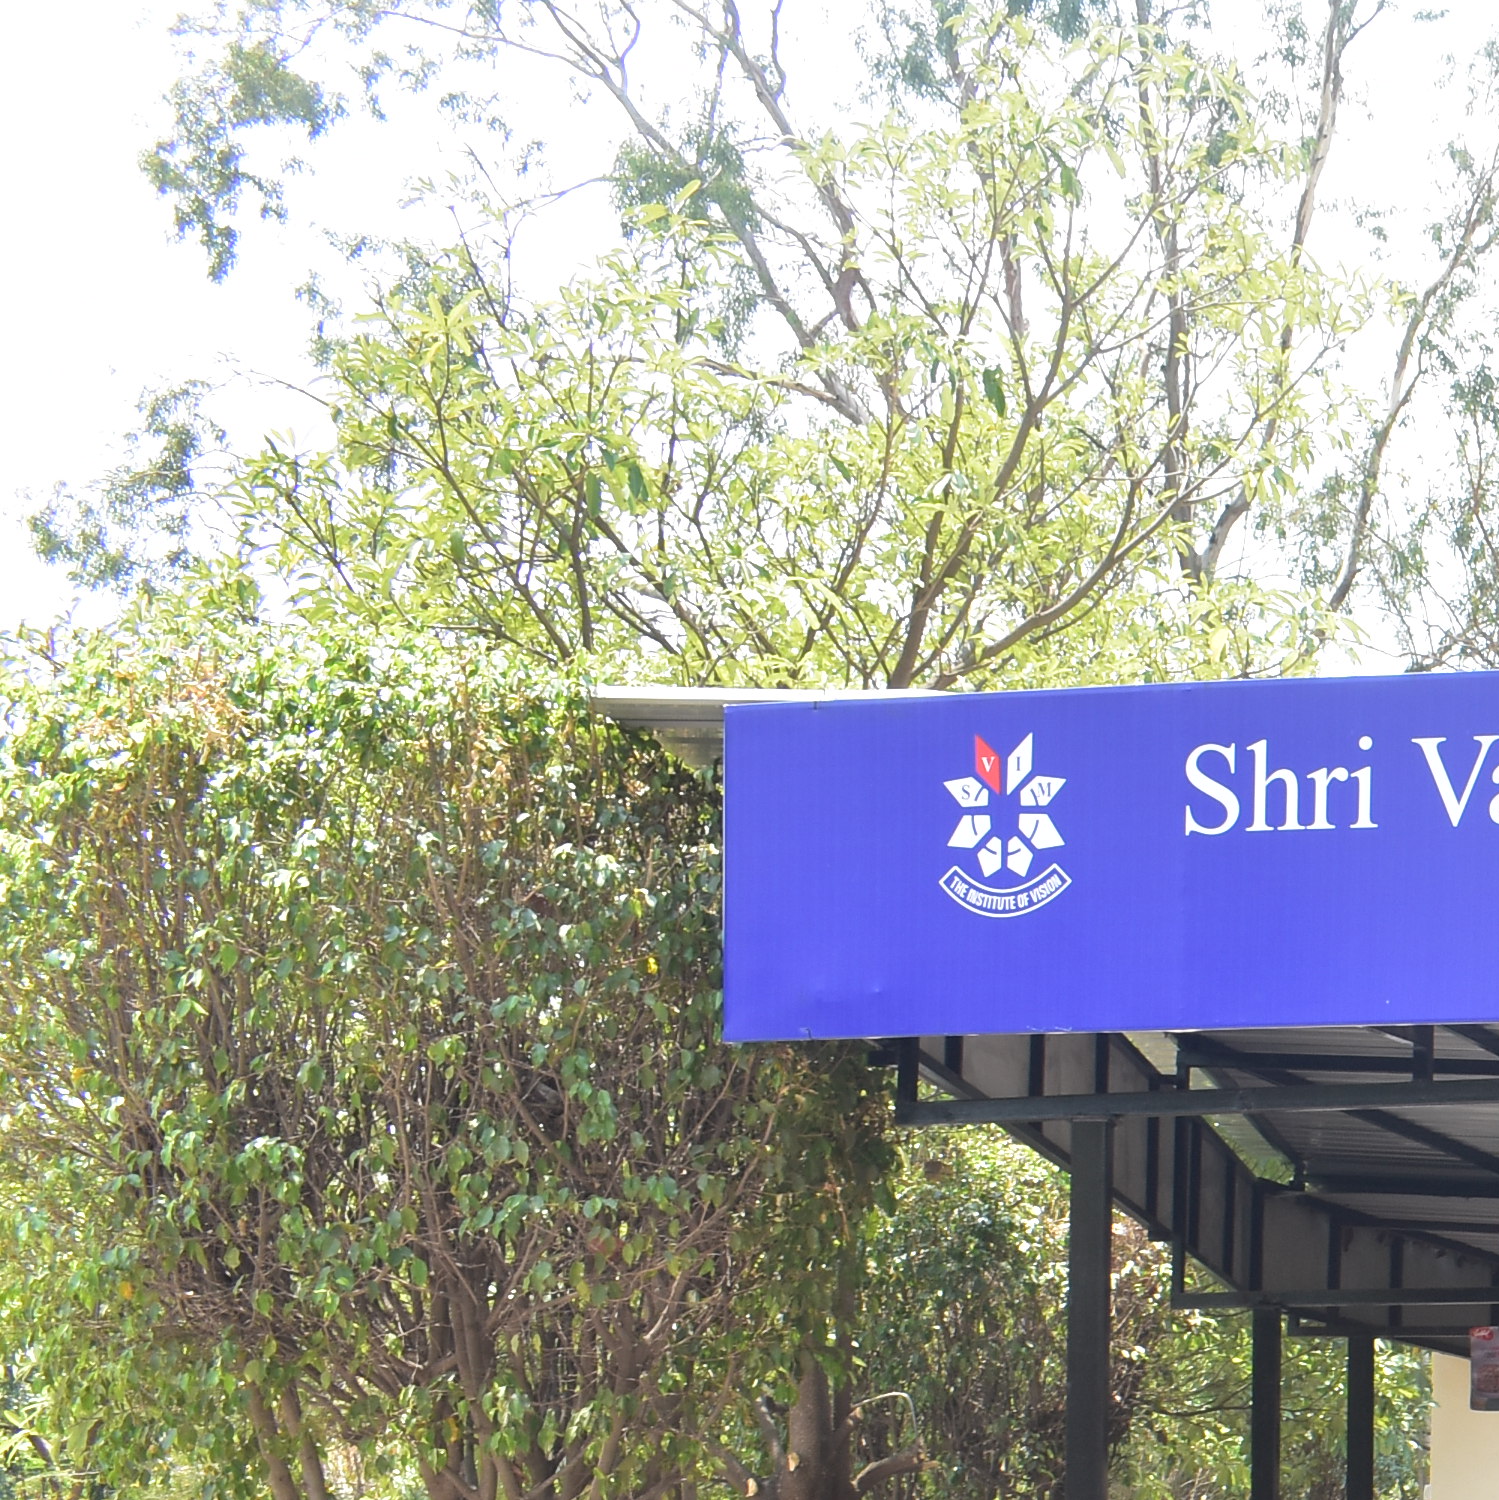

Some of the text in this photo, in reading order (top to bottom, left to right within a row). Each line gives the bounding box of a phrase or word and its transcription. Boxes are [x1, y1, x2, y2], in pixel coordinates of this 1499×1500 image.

[1183, 735, 1380, 837] Shri
[949, 873, 1063, 911] THE INSTITUTE OF VISION
